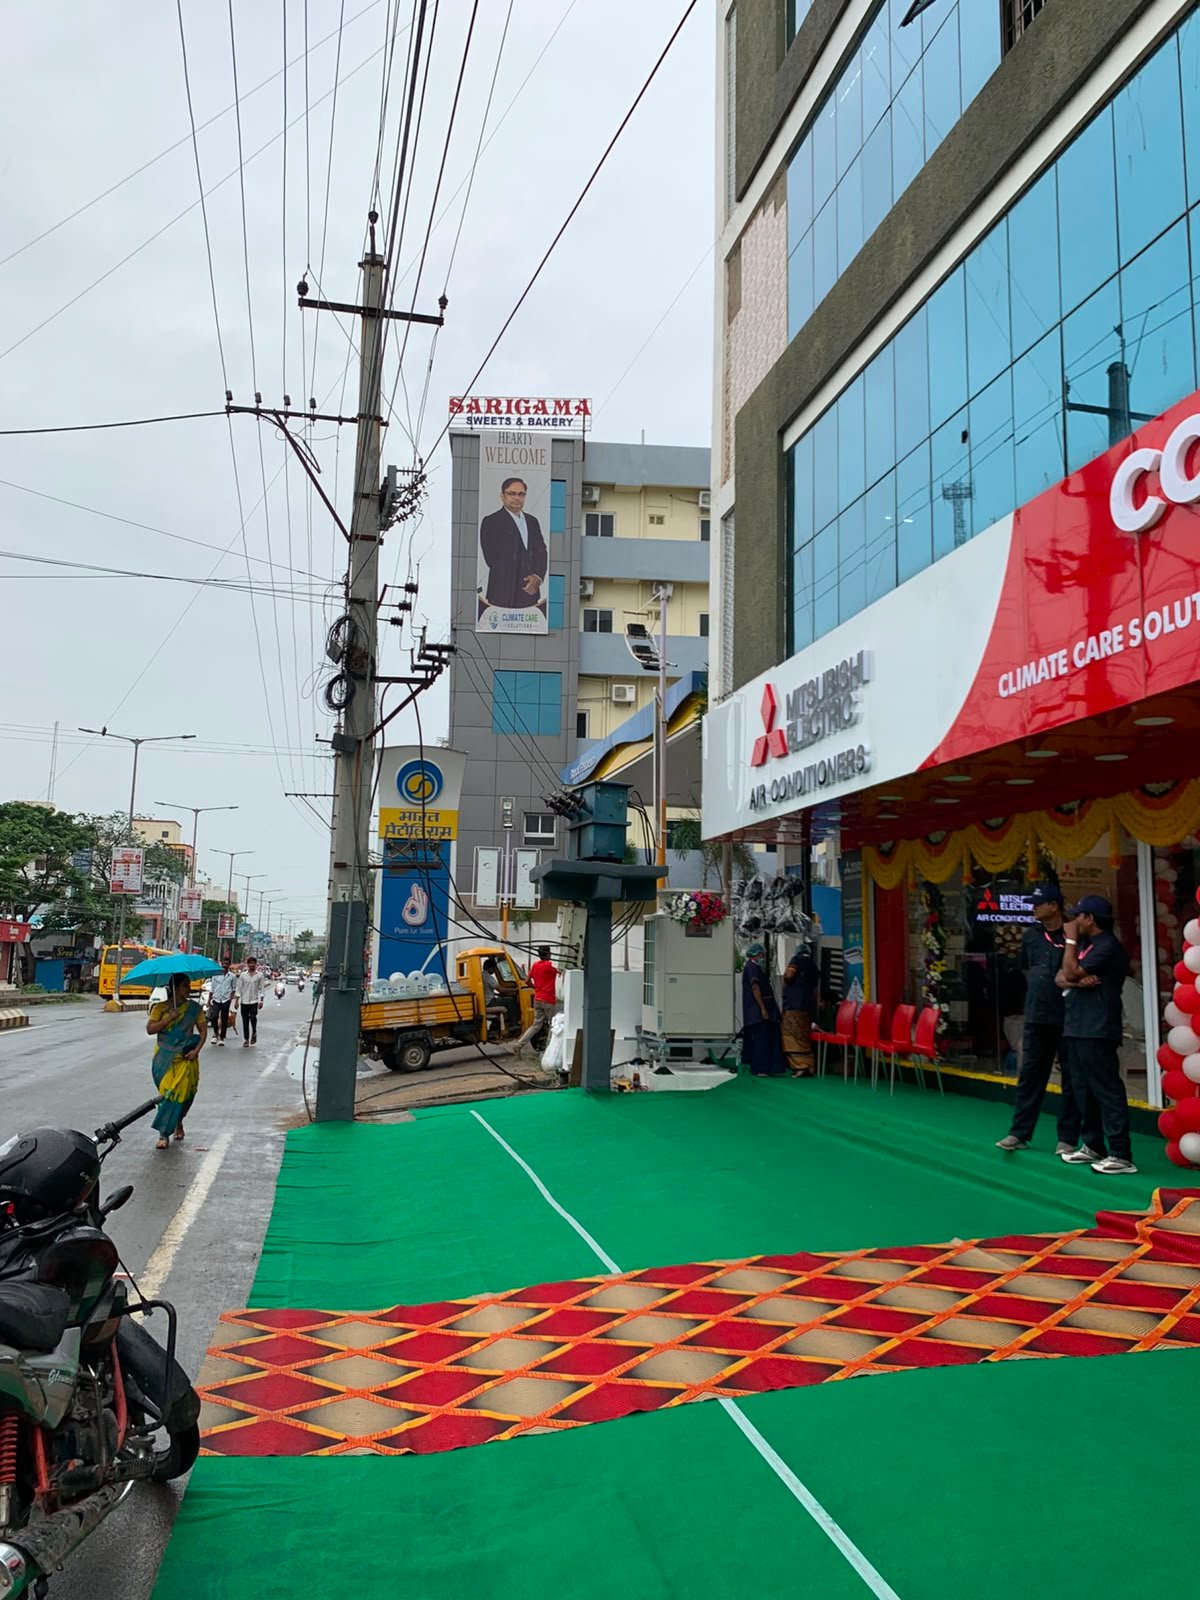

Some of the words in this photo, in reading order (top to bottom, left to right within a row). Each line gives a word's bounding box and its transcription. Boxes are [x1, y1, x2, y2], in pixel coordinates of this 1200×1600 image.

[449, 397, 591, 416] SARIGAMA
[466, 416, 512, 426] SWEETS
[516, 417, 523, 426] &
[528, 417, 573, 427] BAKERY
[498, 431, 533, 446] HEARTY
[485, 446, 546, 466] WELCOME
[502, 613, 524, 622] CLIMATE
[525, 614, 538, 622] CARE
[998, 648, 1068, 698] CLIMATE
[1072, 625, 1124, 668] CARE
[786, 650, 869, 721] MITSUBISHI
[786, 694, 861, 752] ELECTRIC
[750, 783, 769, 810] AIR
[770, 745, 870, 803] CONDITIONERS
